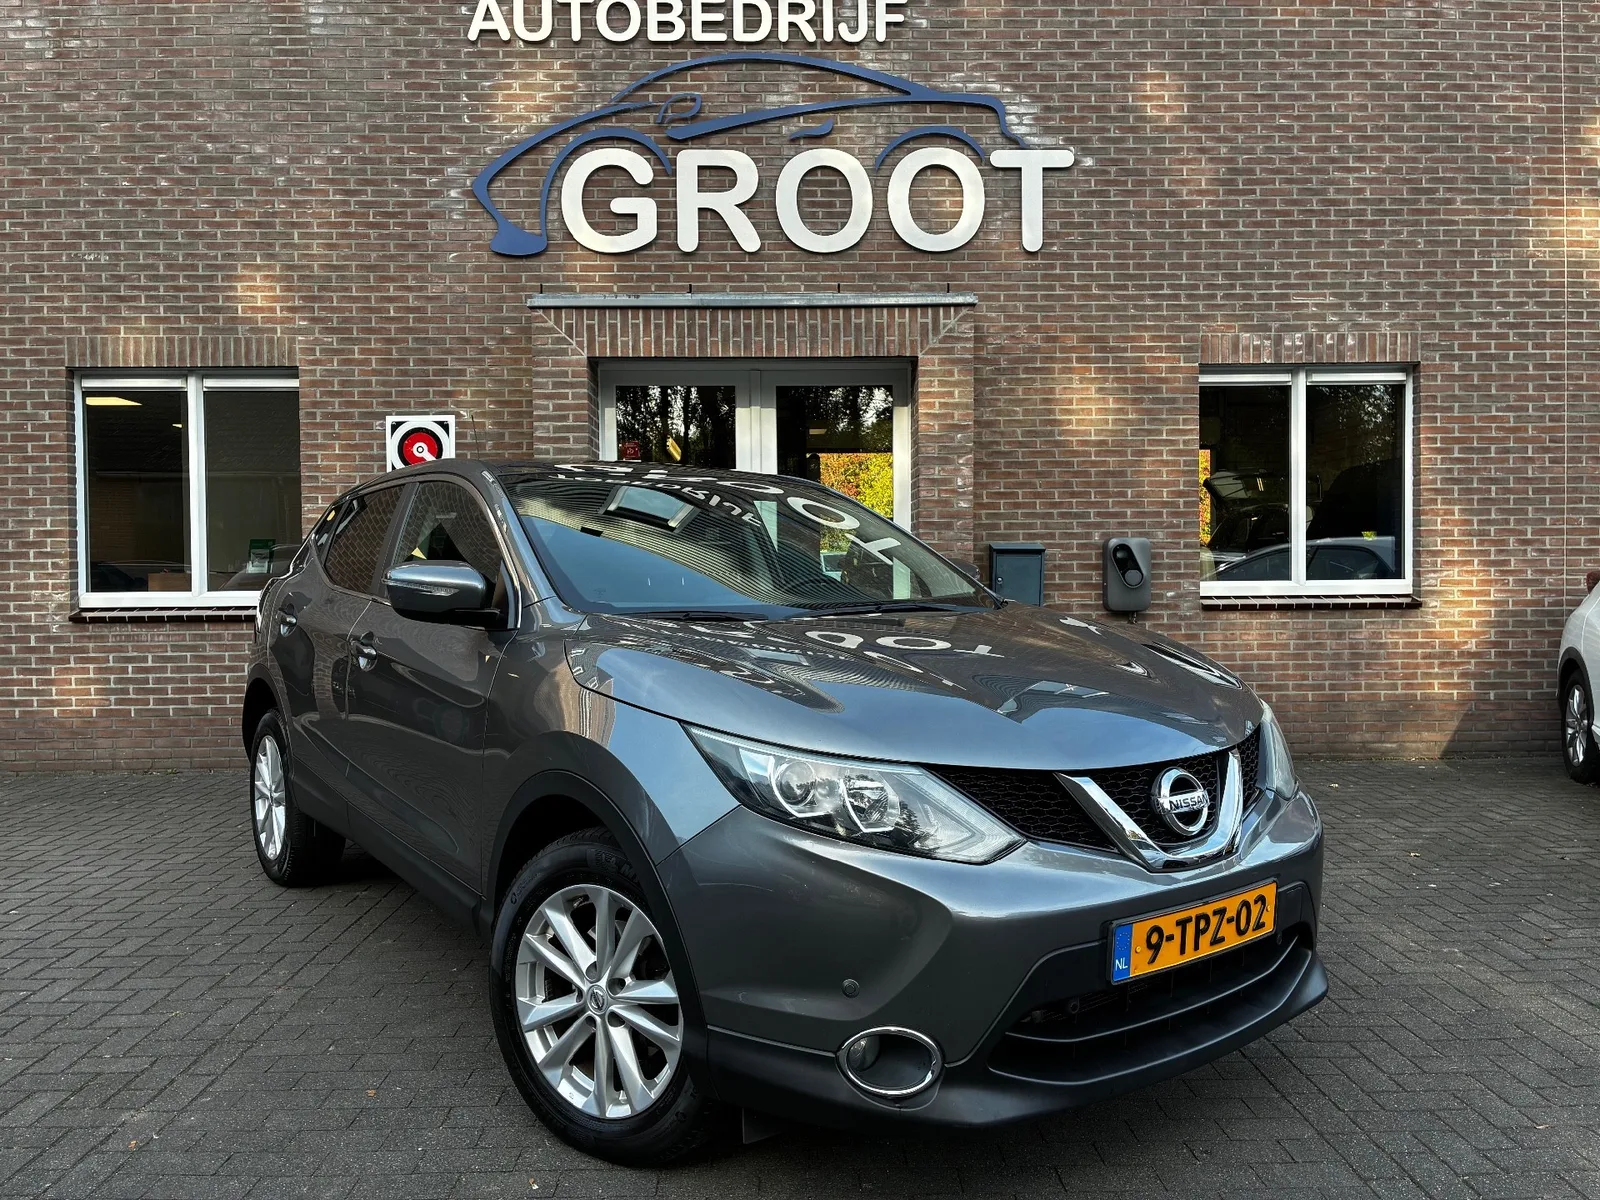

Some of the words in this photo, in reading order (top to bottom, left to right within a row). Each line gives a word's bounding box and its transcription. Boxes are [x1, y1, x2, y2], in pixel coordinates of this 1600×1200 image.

[467, 0, 906, 43] AUTOBEDRIJF
[561, 148, 1075, 253] GROOT
[1169, 794, 1208, 811] NISSAN
[1145, 894, 1267, 965] 9-TPZ-02
[1115, 957, 1128, 969] NL
